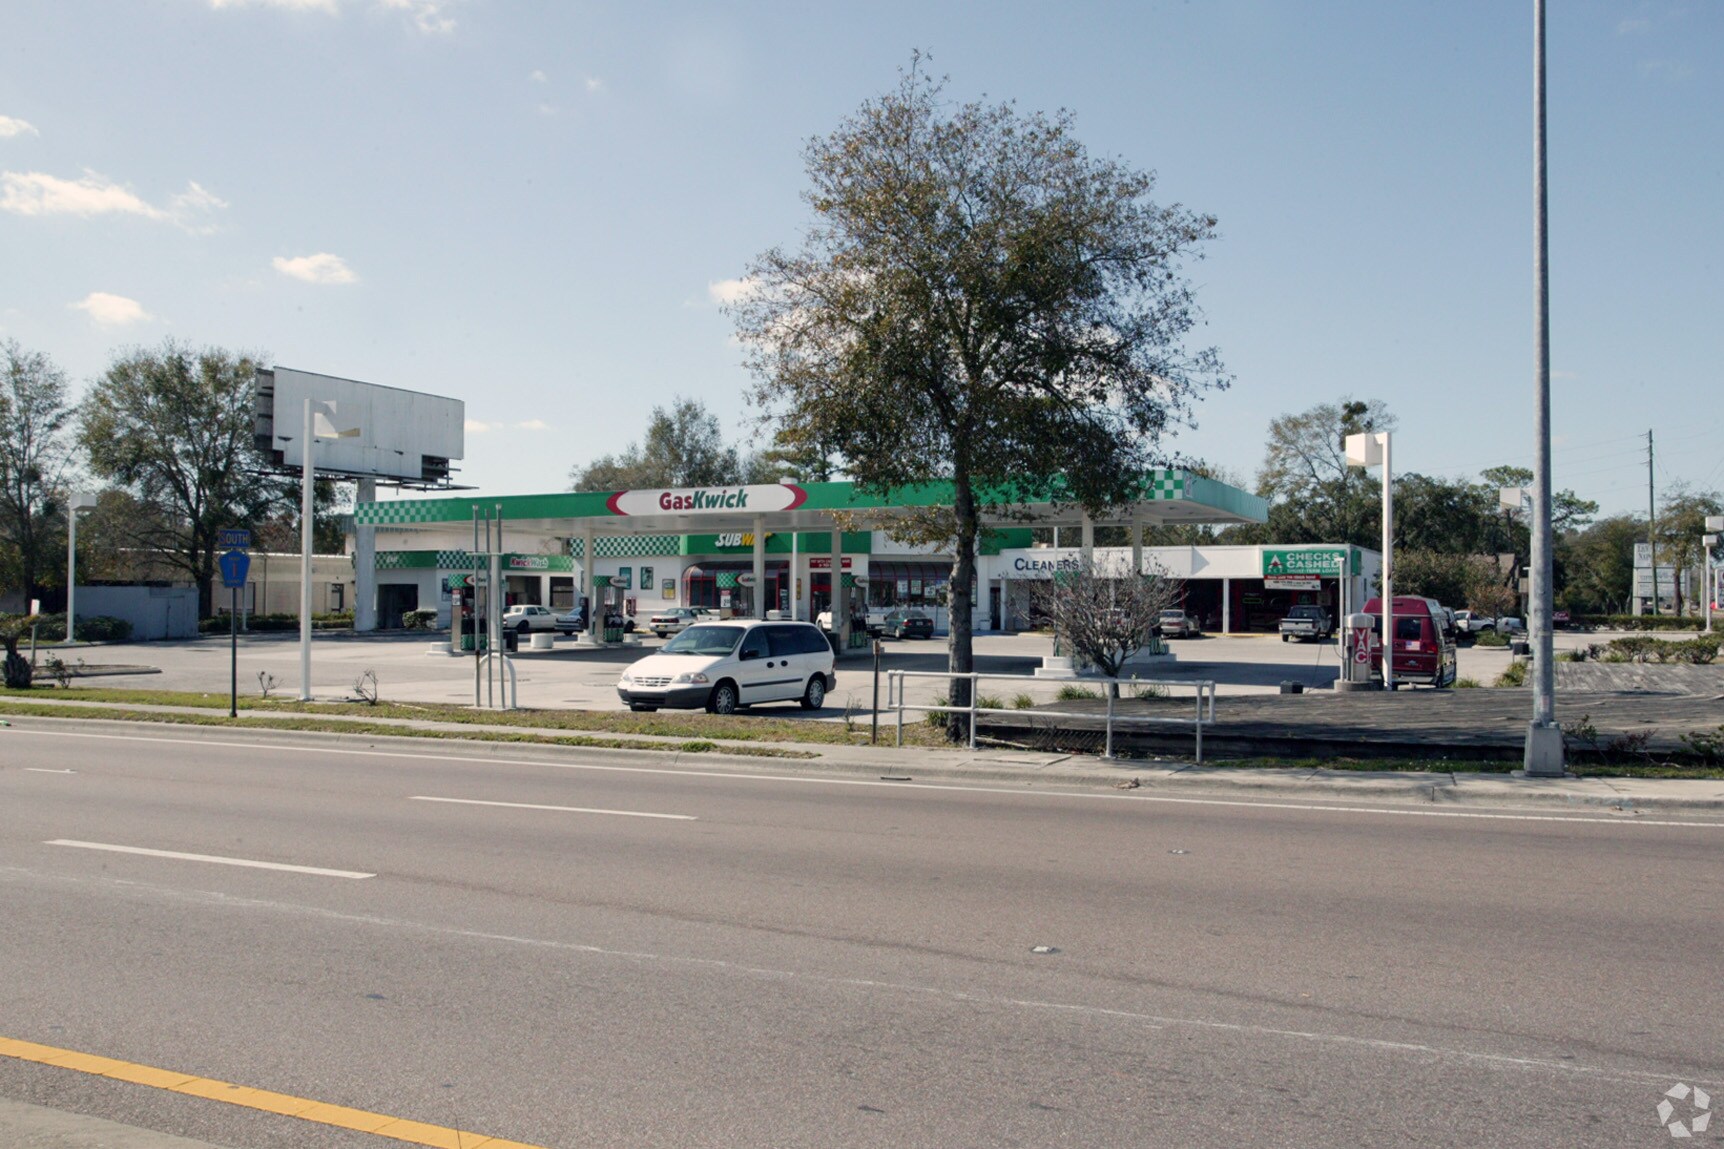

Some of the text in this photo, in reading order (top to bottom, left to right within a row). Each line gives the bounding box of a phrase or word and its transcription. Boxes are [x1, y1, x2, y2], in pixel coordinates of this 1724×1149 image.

[659, 488, 748, 510] GasKwick
[715, 533, 772, 547] SUBW
[1286, 552, 1340, 560] CHECKS
[1286, 560, 1340, 568] CASHED
[1355, 628, 1367, 664] VAC
